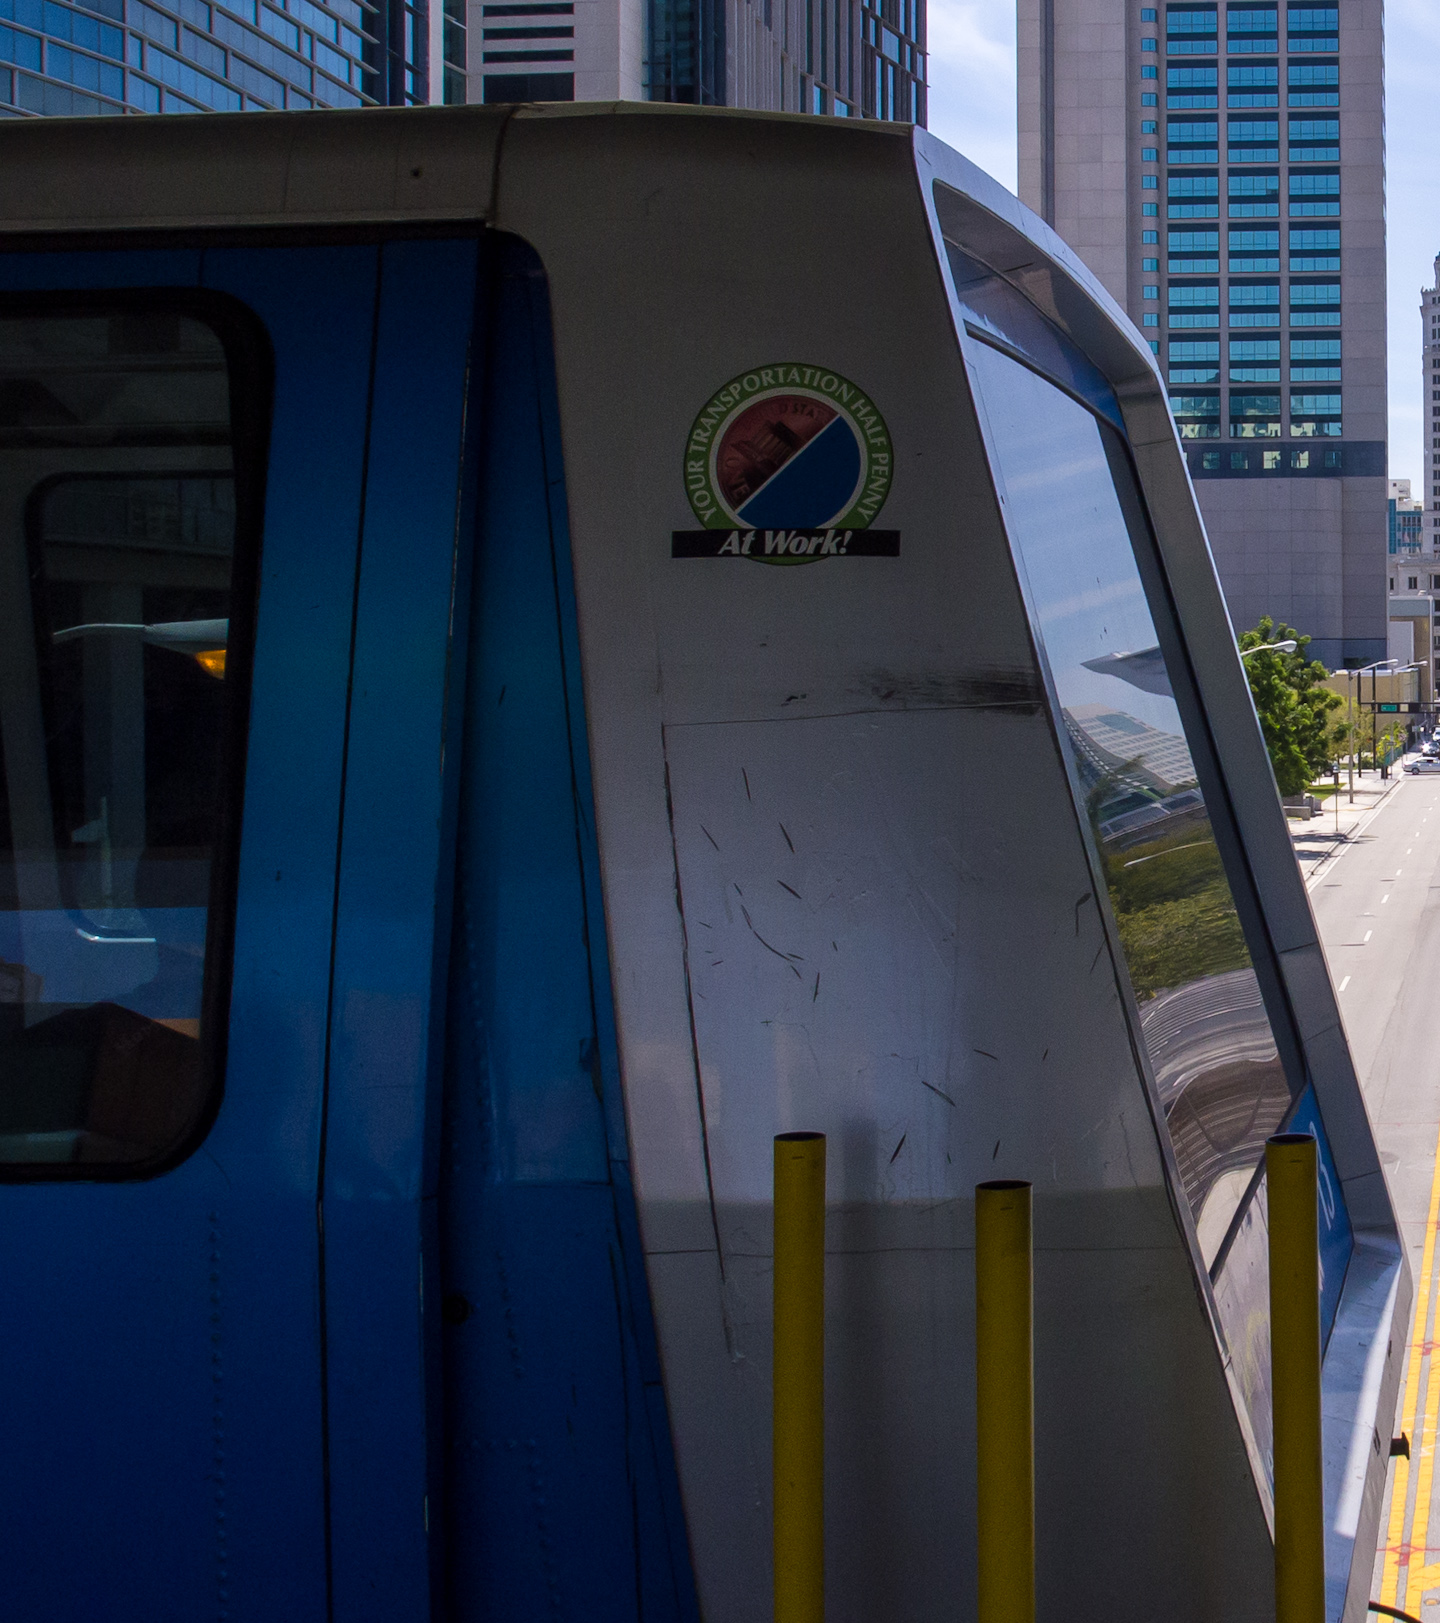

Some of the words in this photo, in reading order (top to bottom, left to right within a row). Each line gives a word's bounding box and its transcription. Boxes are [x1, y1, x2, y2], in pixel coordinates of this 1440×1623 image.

[689, 367, 855, 453] TRANSPORTATION
[850, 399, 887, 446] HALF
[688, 460, 717, 522] YOUR
[857, 453, 889, 521] PENNY
[717, 531, 756, 554] At
[764, 530, 853, 555] Work!
